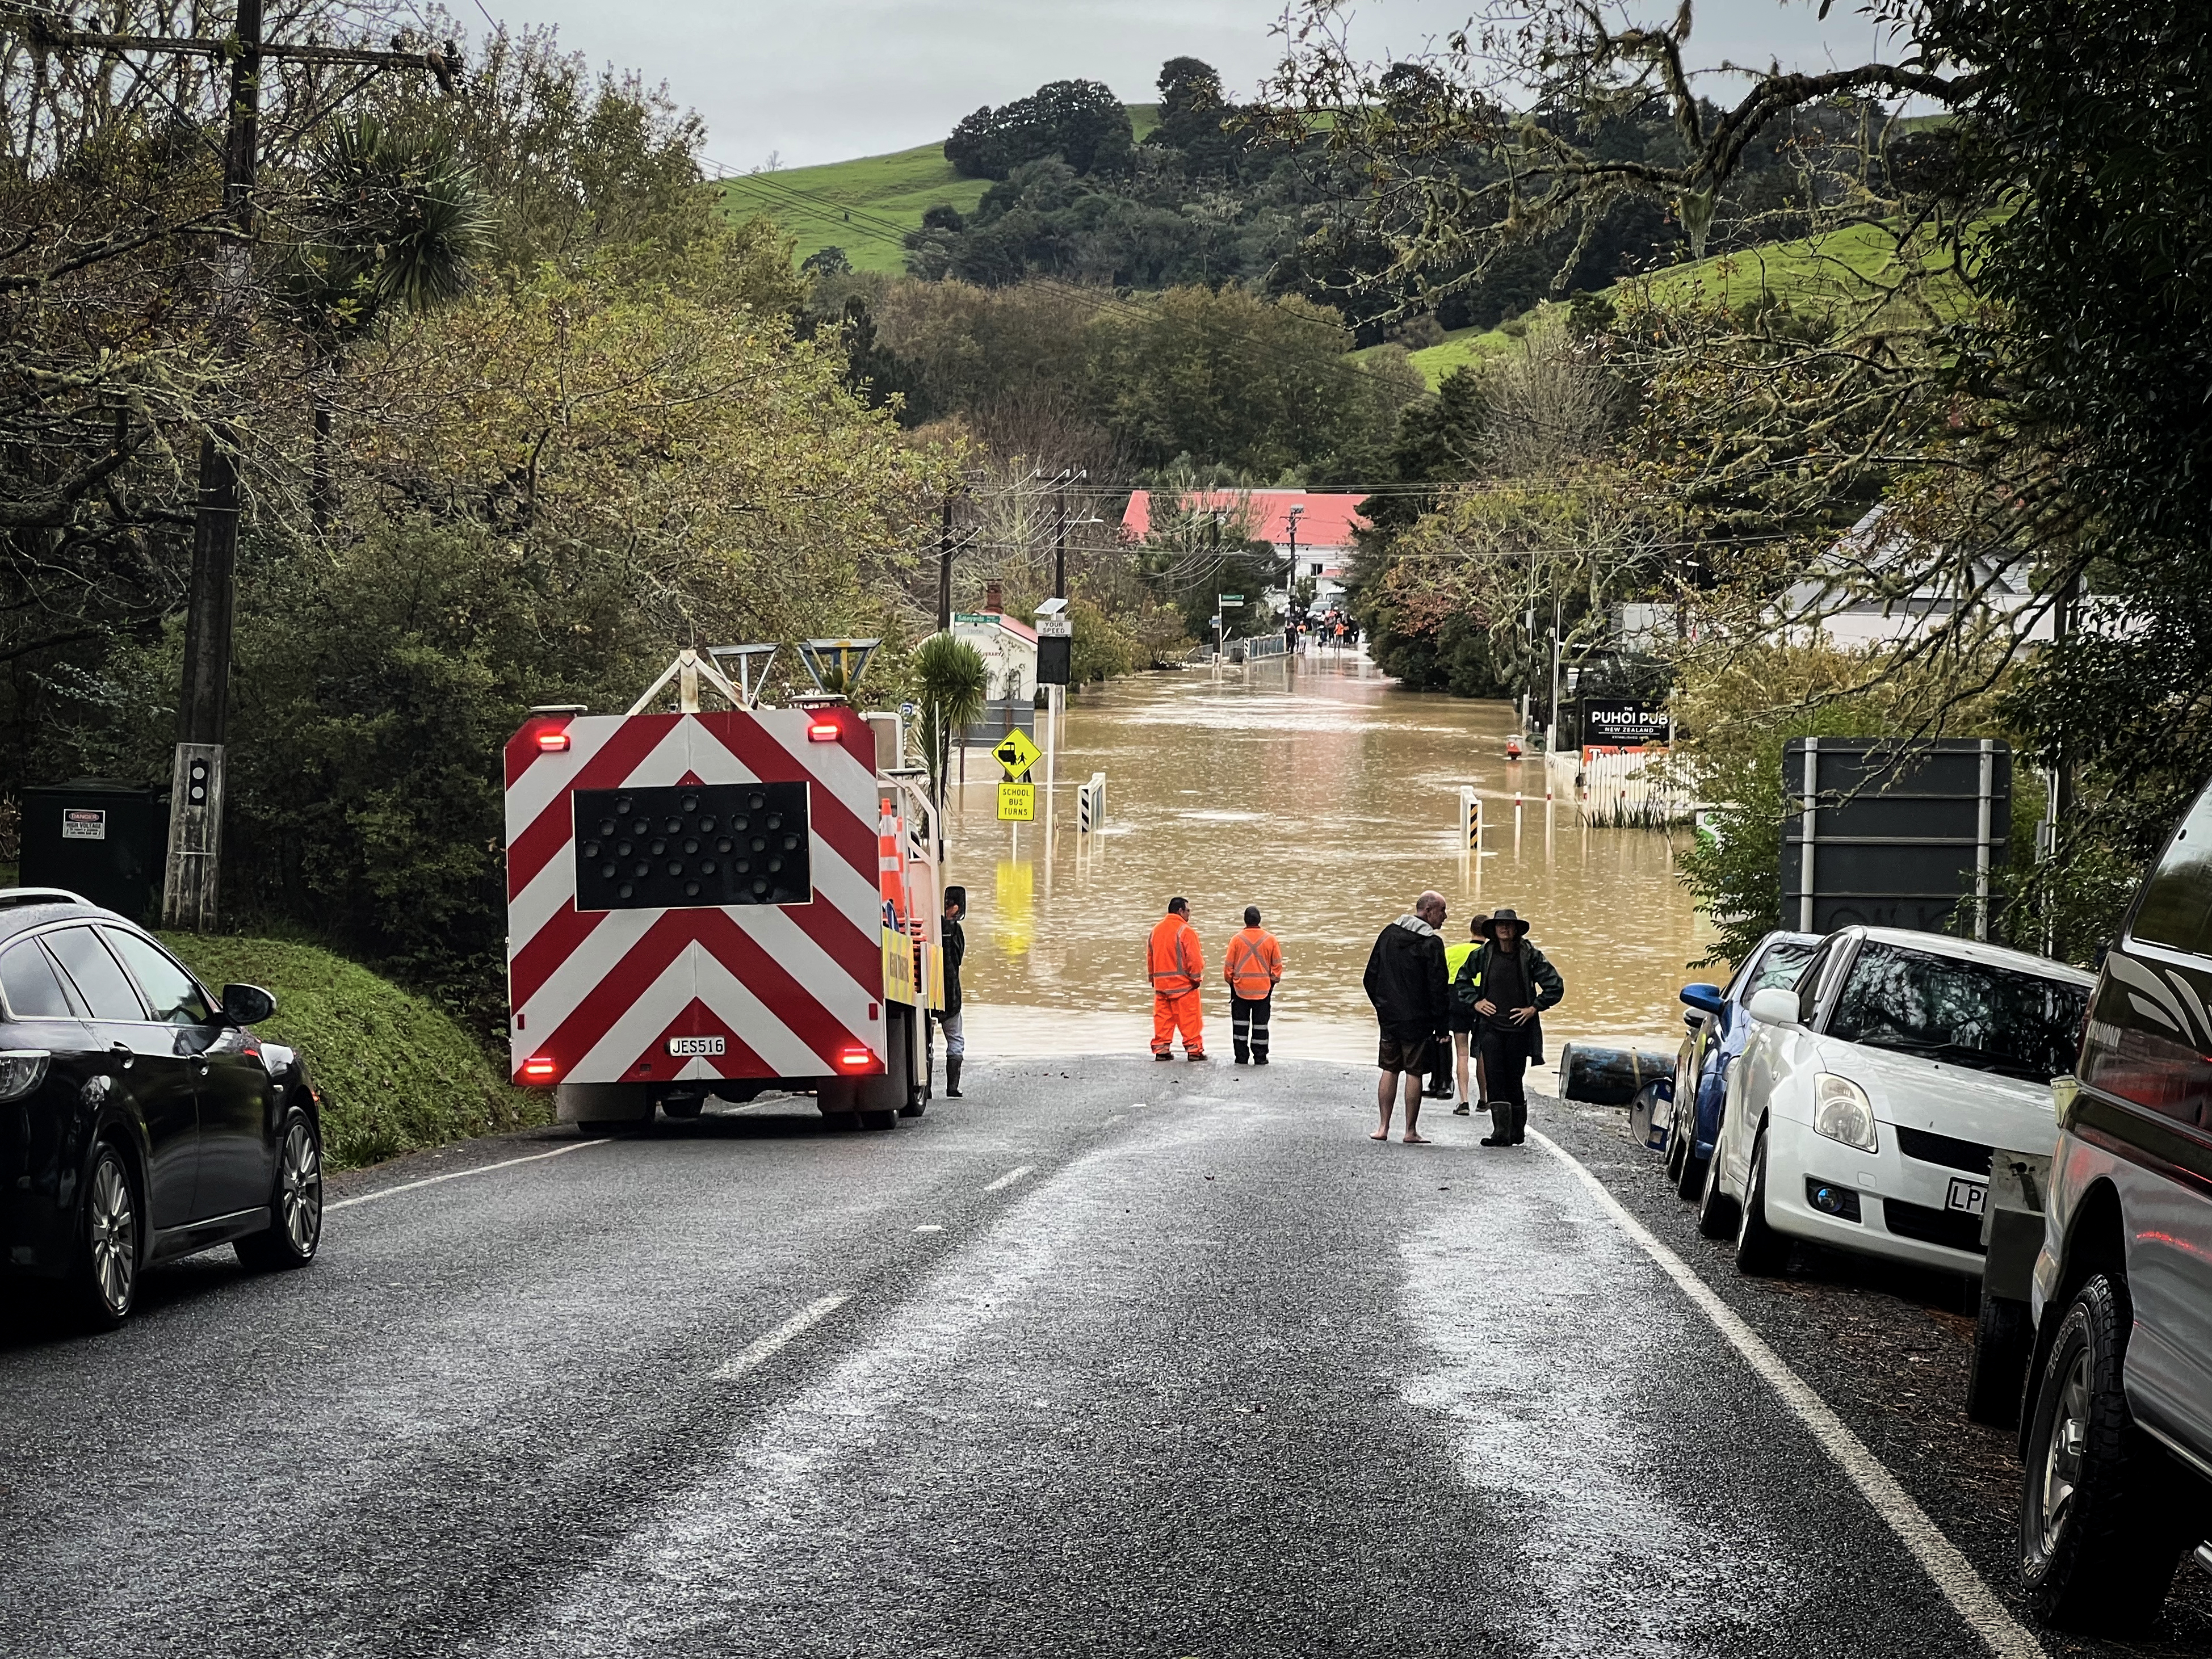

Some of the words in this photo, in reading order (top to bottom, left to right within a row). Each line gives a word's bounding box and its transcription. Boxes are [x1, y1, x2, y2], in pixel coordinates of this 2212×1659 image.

[1592, 711, 1636, 724] PUHOI
[1639, 712, 1668, 725] PUB
[673, 1040, 723, 1053] JES516
[1951, 1186, 1988, 1213] LP
